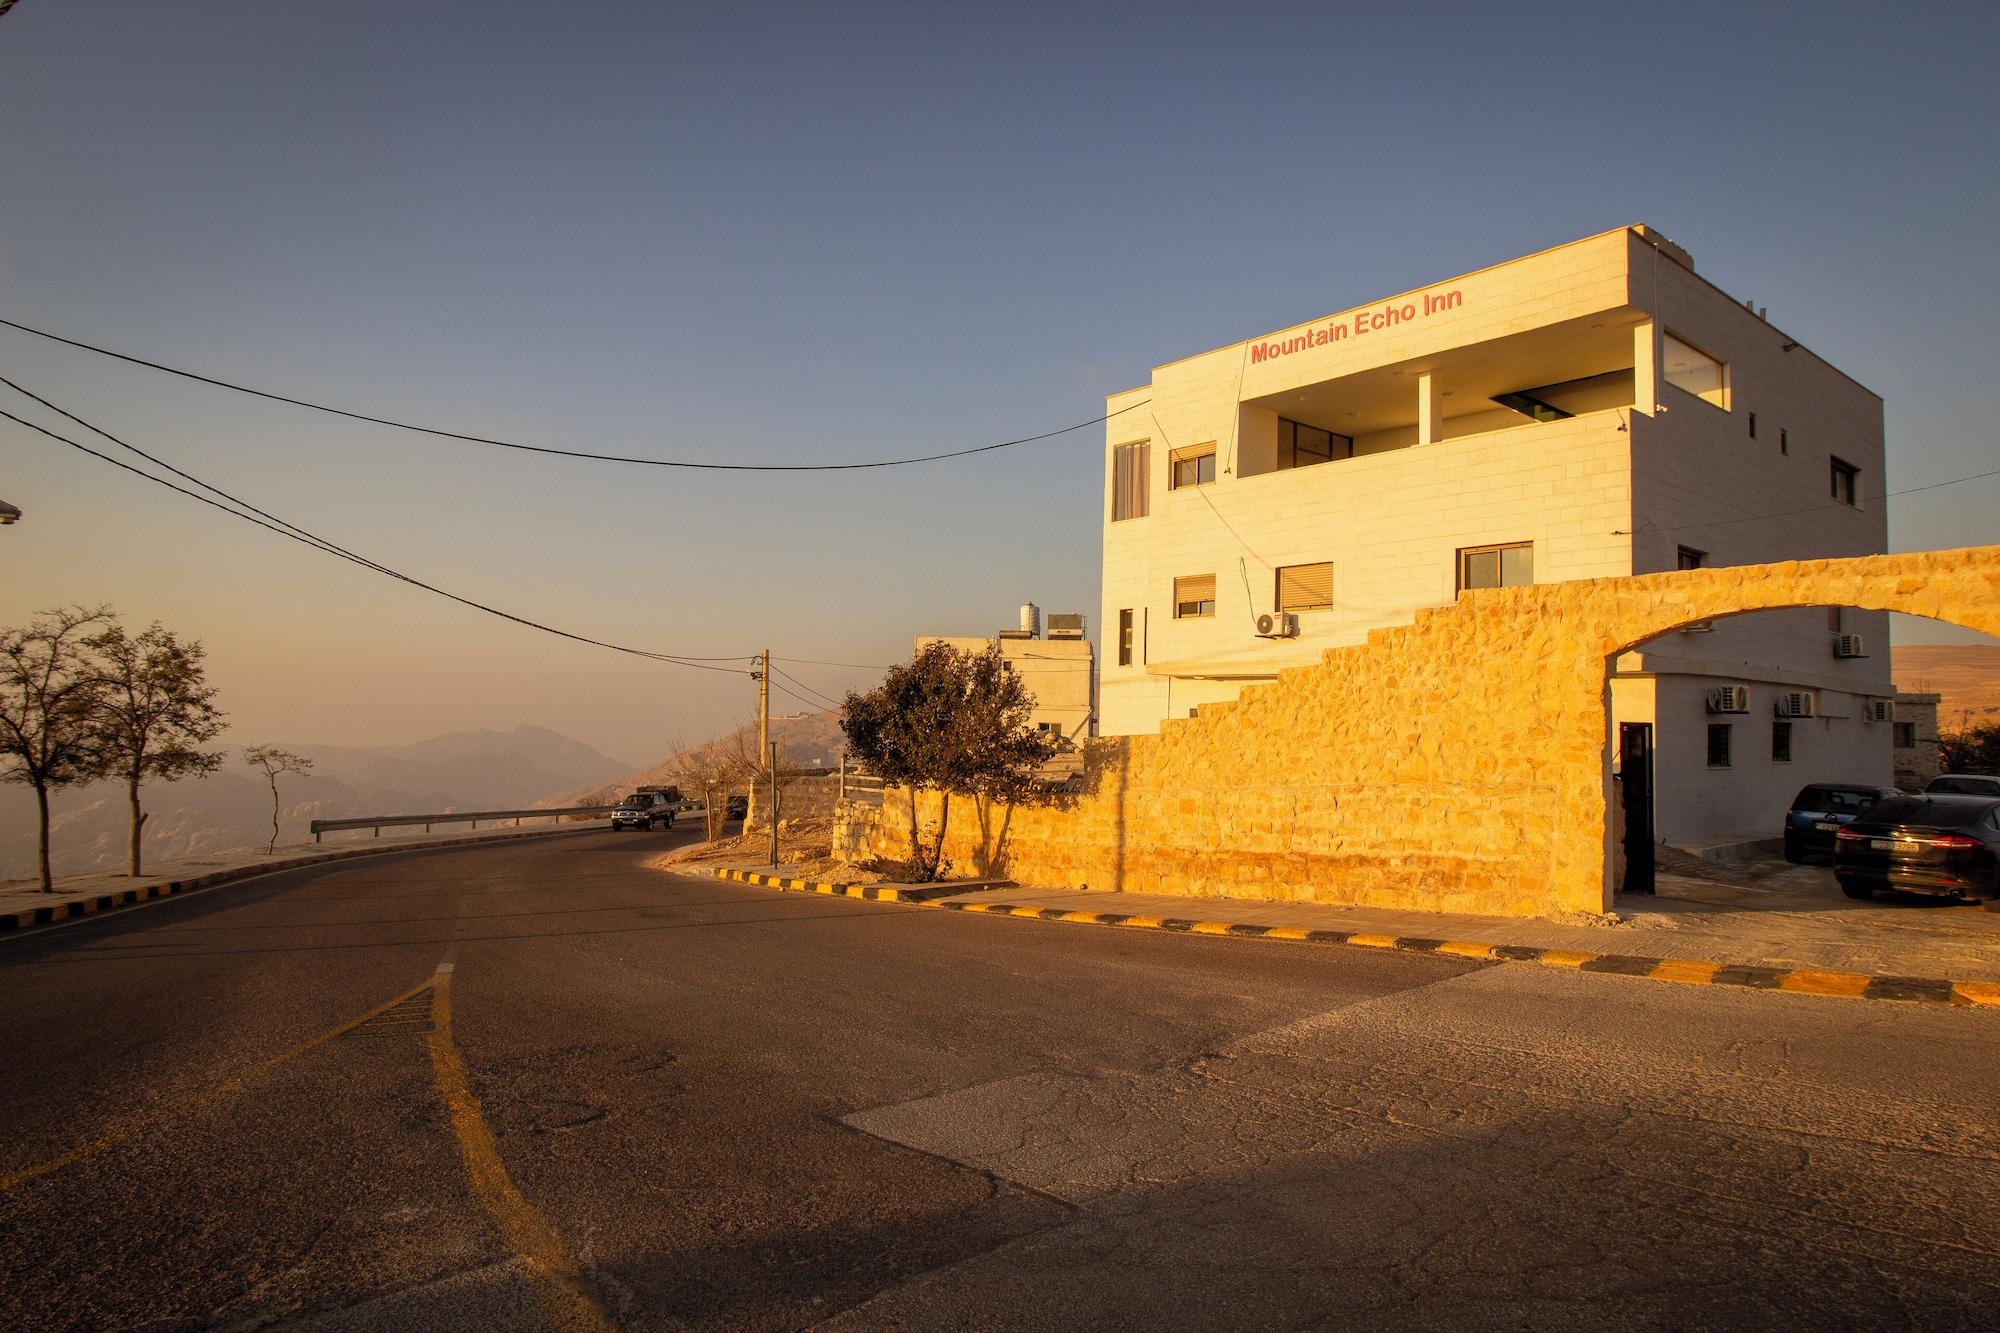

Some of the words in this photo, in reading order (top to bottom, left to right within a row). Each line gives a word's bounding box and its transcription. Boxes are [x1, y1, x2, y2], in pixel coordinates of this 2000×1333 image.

[1251, 322, 1348, 364] Mountain
[1354, 303, 1416, 335] Echo
[1423, 290, 1462, 316] Inn
